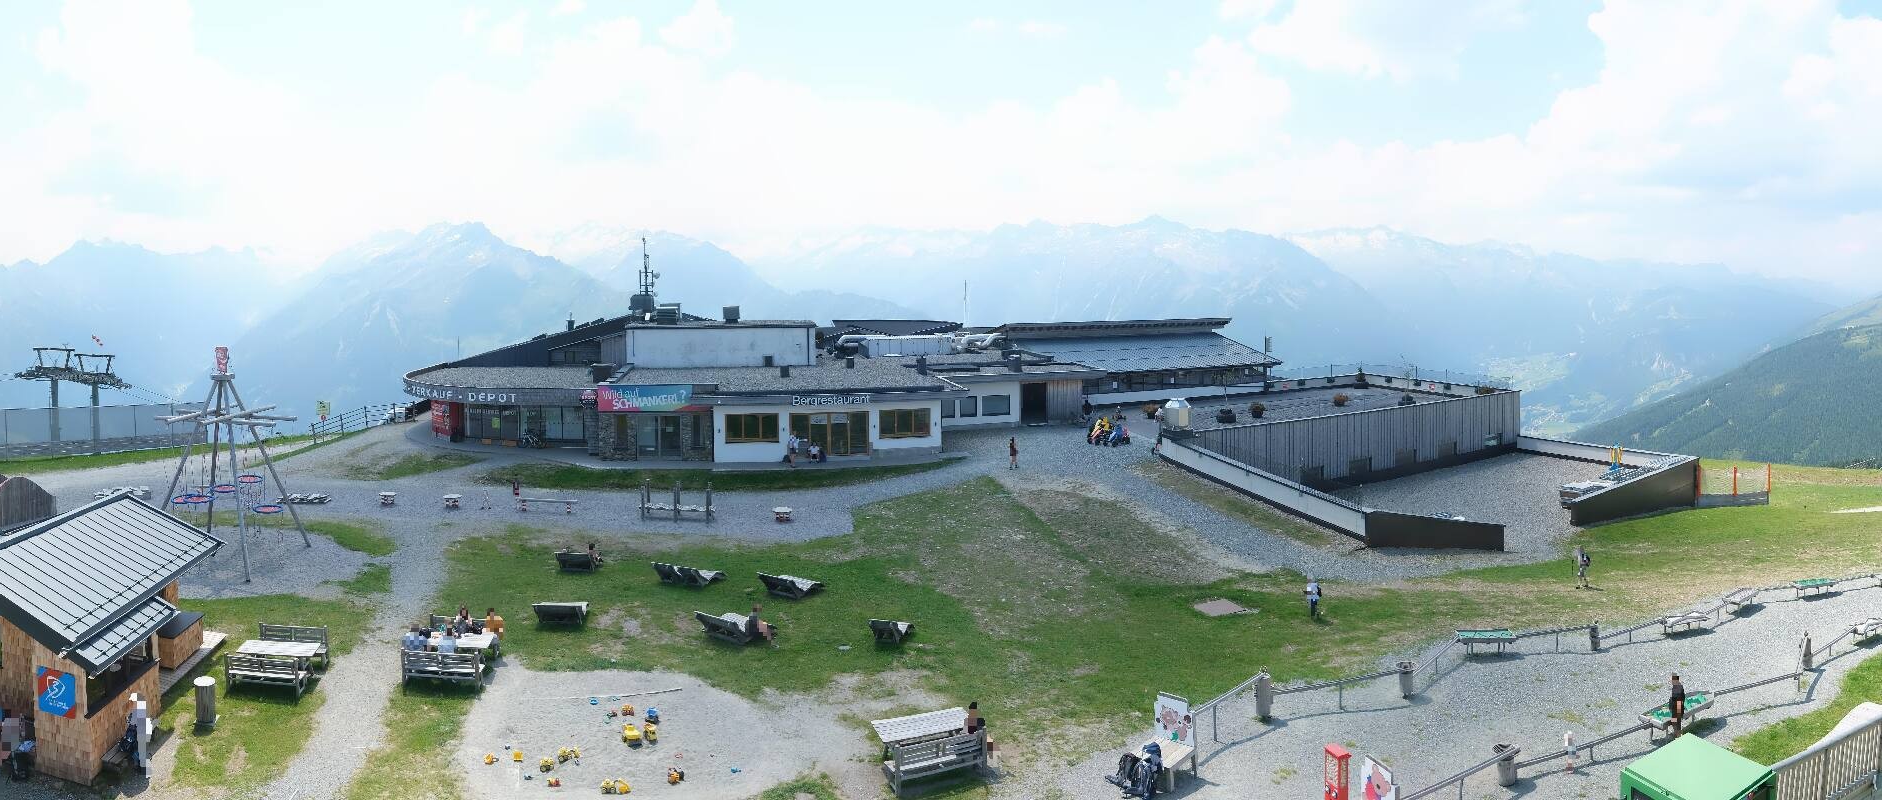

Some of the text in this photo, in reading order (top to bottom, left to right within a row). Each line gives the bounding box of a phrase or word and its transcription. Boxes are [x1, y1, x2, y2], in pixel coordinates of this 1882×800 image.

[468, 392, 517, 403] DEPOT
[602, 387, 640, 400] Wild auf
[792, 394, 870, 406] Bergrestaurant
